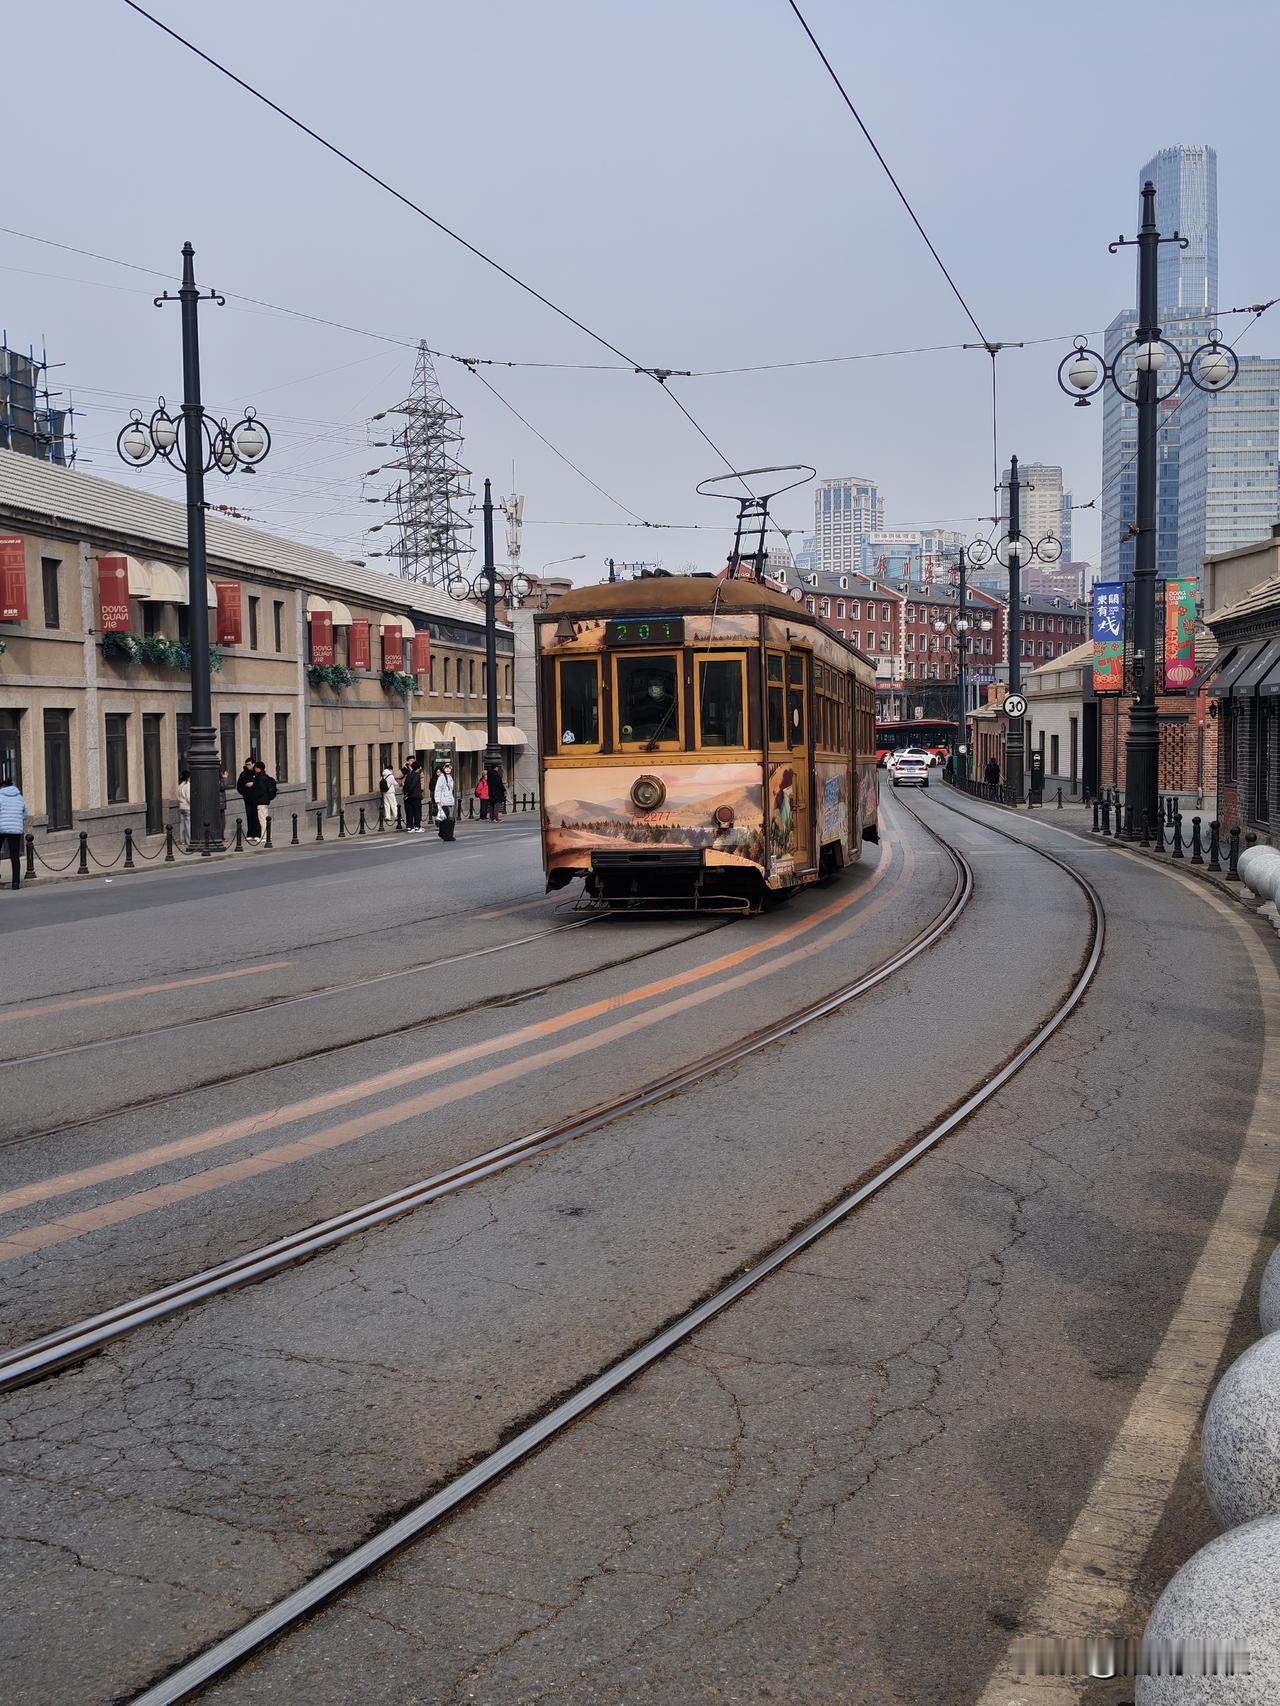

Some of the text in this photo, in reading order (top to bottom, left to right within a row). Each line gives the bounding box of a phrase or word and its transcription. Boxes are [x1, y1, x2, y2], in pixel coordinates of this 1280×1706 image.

[102, 605, 128, 613] DONG
[102, 613, 128, 621] GUAN
[616, 623, 671, 641] 201
[1008, 701, 1023, 713] 30
